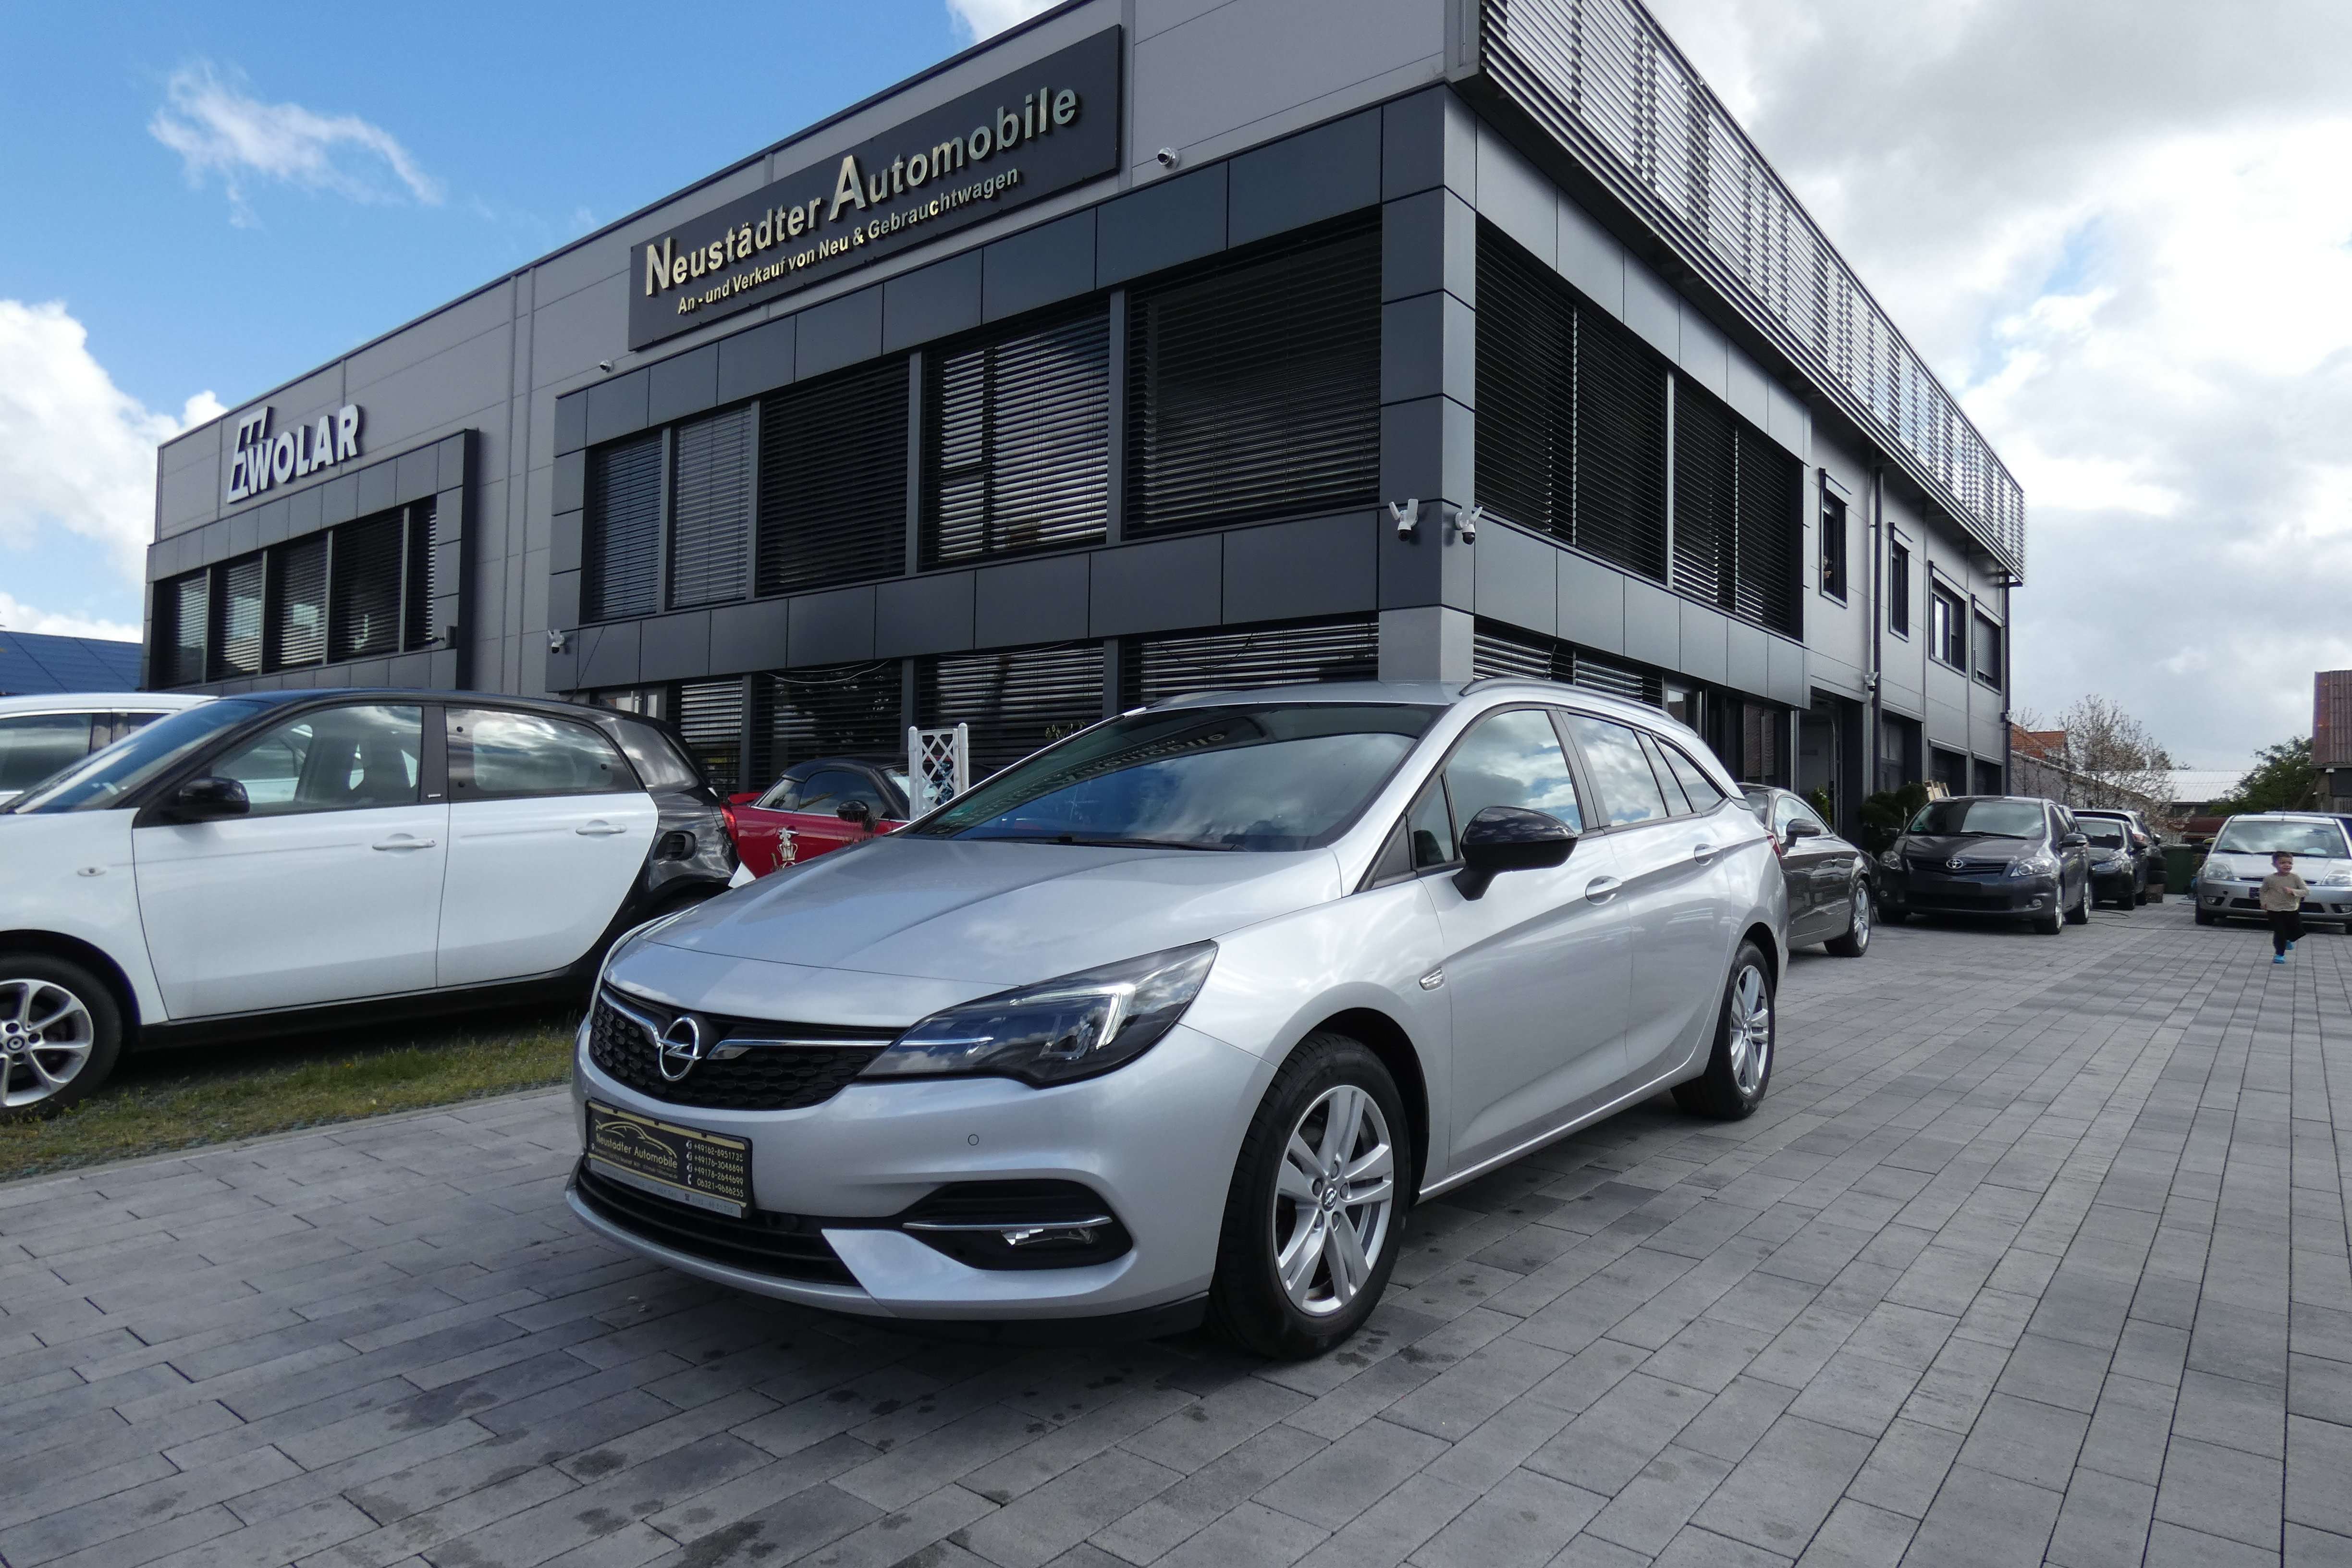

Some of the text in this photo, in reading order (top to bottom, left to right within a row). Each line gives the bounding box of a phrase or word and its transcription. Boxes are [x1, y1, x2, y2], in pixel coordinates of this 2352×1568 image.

[646, 86, 1077, 296] Neustädter Automobile
[706, 279, 730, 304] und
[733, 257, 786, 293] Verkauf
[788, 248, 815, 271] von
[819, 235, 848, 259] Neu
[853, 226, 864, 245] &
[868, 168, 1018, 239] Gebrauchtwagen
[634, 1146, 678, 1168] Automobile
